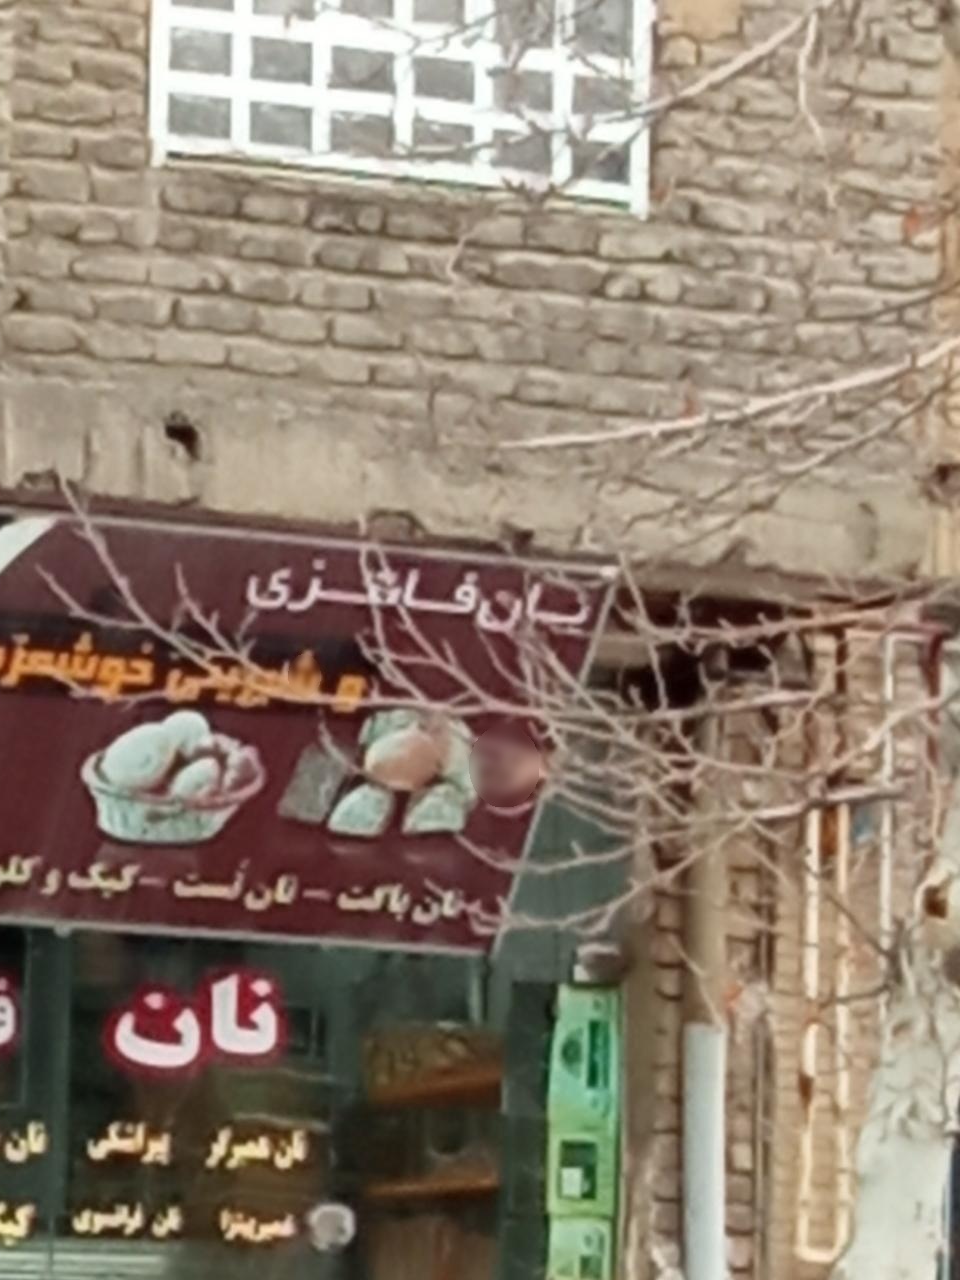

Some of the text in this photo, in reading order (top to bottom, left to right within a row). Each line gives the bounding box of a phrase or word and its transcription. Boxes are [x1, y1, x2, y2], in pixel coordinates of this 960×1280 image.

[41, 867, 61, 896] و
[67, 862, 141, 898] کیک
[244, 873, 298, 912] نان
[115, 974, 279, 1067] نان
[4, 1121, 49, 1164] نان
